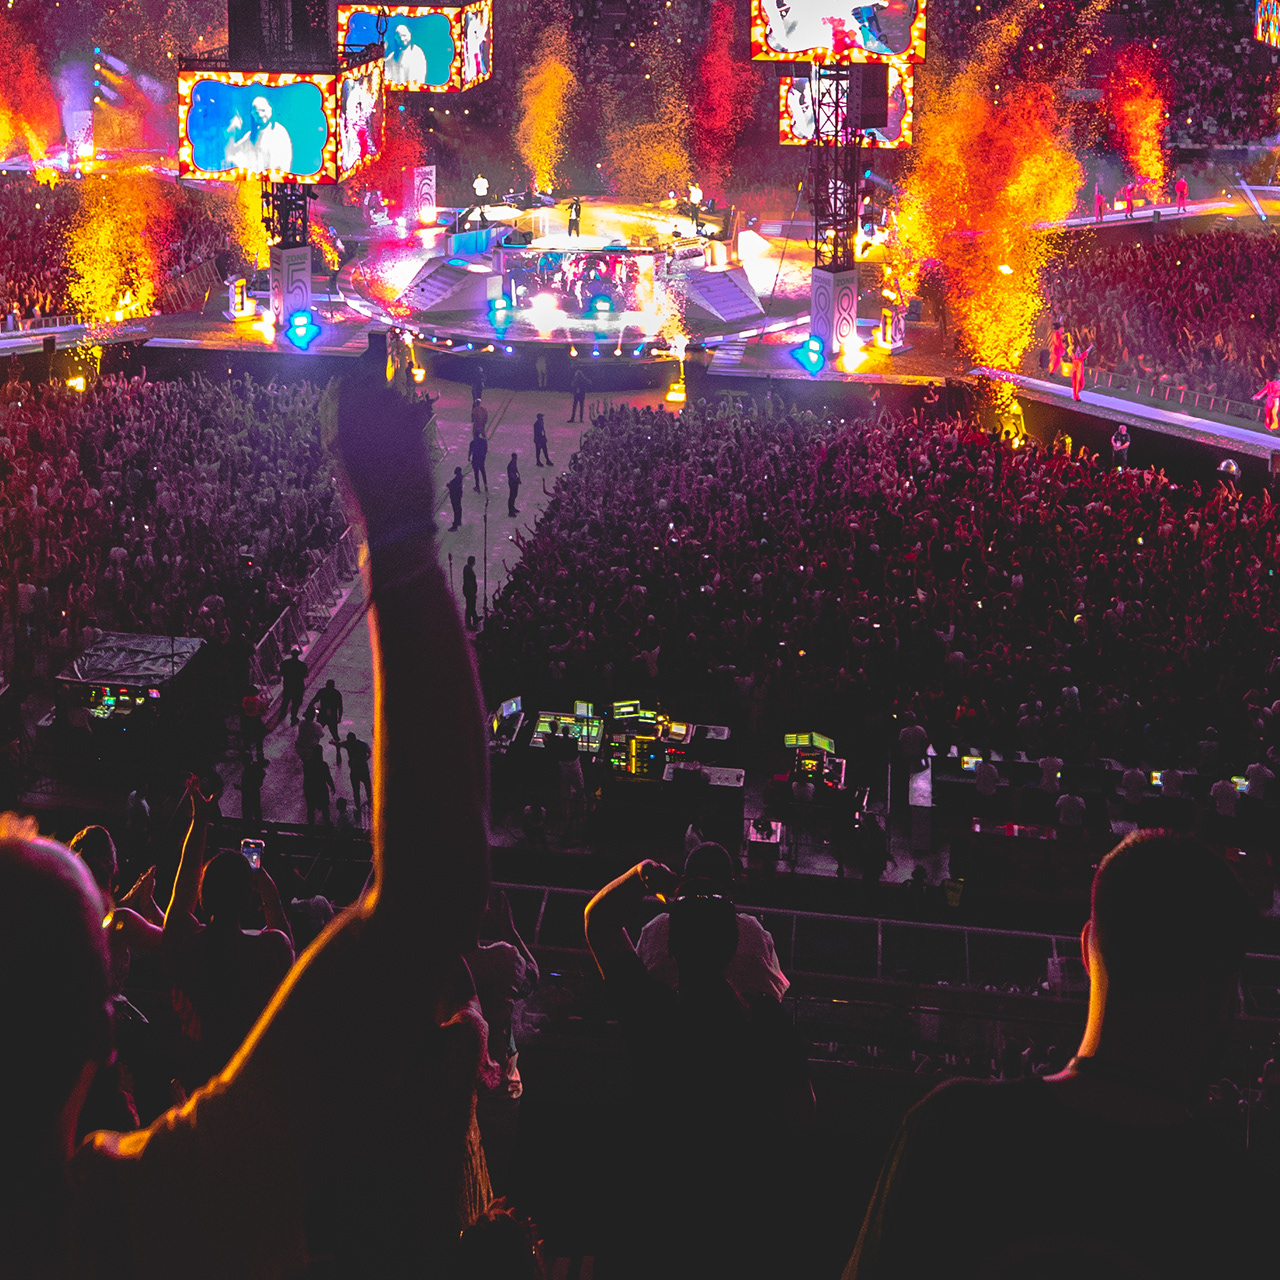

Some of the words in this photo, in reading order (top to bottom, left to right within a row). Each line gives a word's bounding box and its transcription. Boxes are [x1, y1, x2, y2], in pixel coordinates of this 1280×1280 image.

[285, 253, 308, 263] ZONE
[286, 261, 308, 318] 5
[814, 275, 831, 286] ZONE
[836, 276, 855, 287] ZONE
[814, 285, 831, 343] 8
[836, 286, 855, 344] 8
